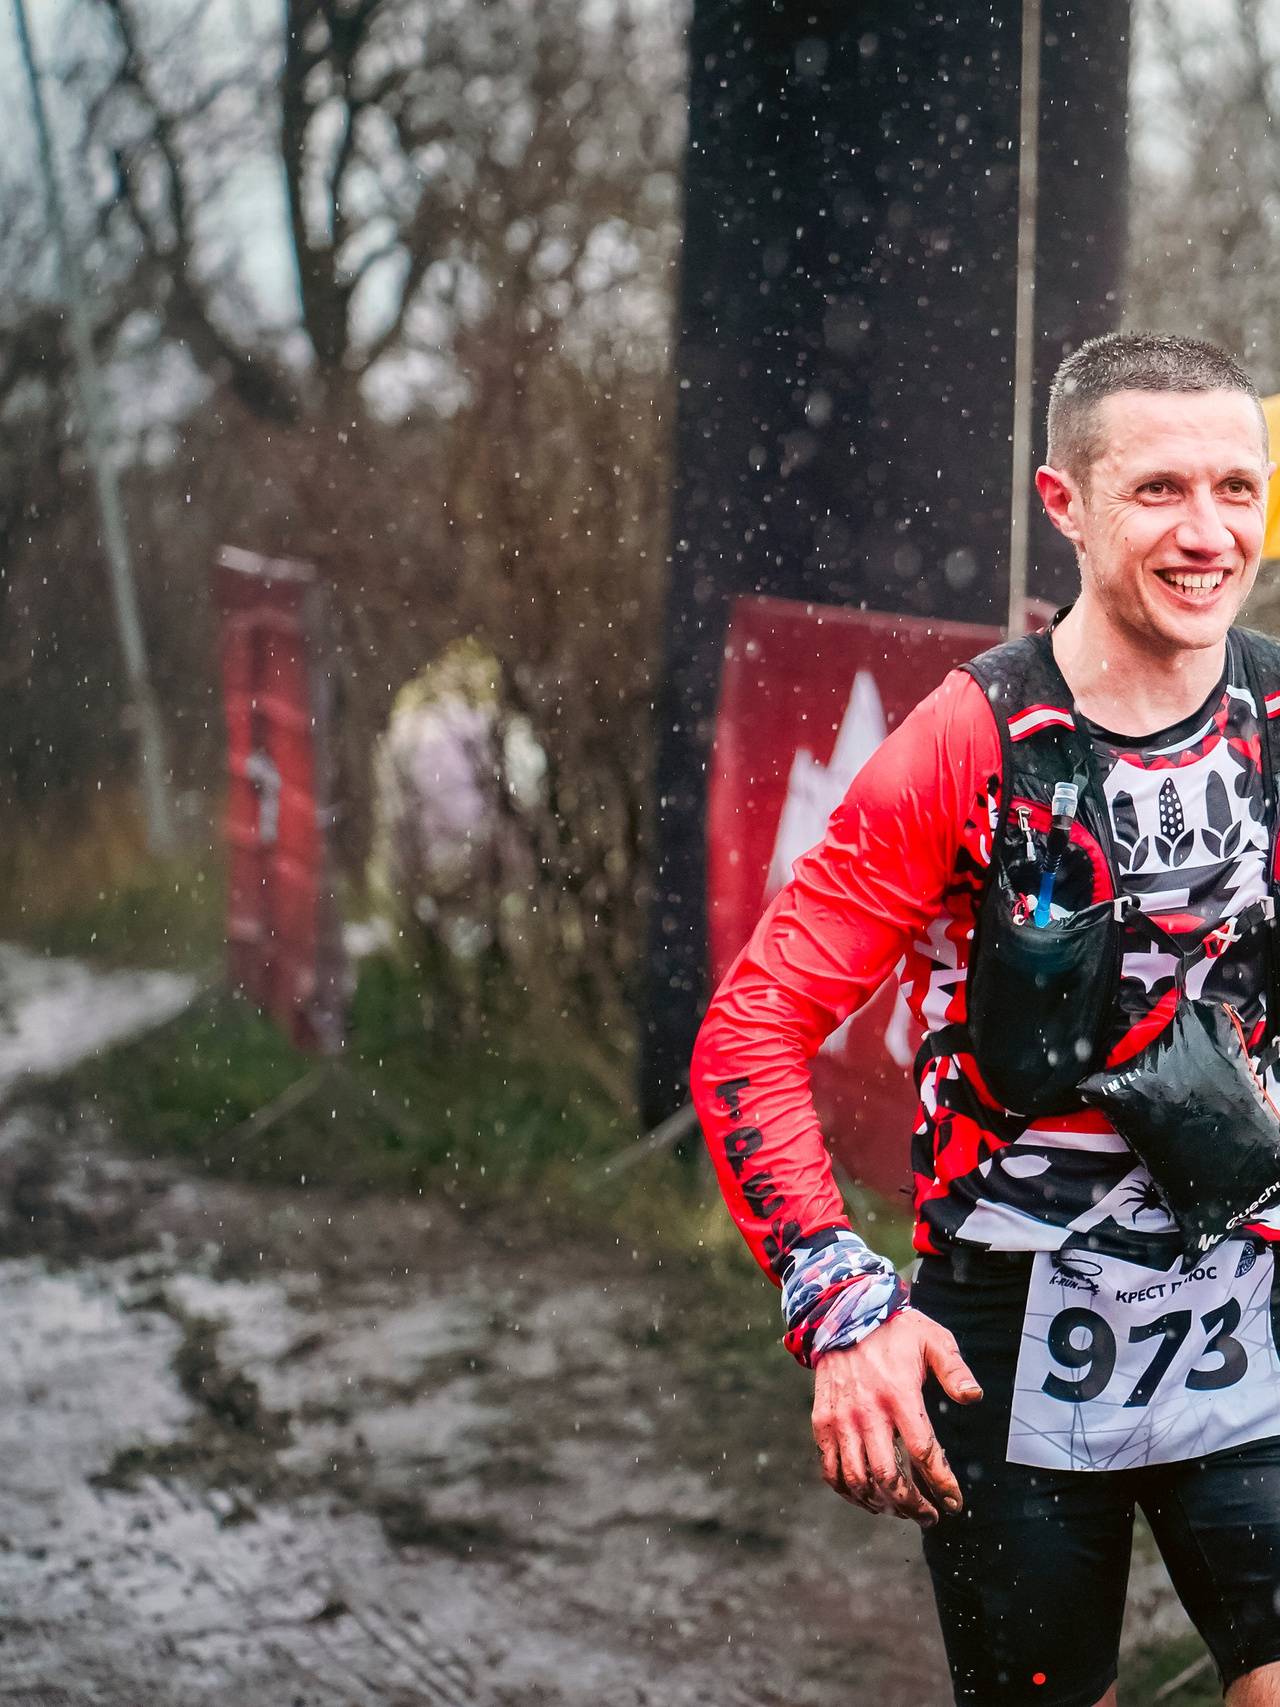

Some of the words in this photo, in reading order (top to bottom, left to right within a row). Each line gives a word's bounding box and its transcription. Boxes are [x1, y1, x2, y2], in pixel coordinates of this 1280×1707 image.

[1049, 1275, 1079, 1289] K-RUN
[1115, 1284, 1166, 1304] КРЕСТ
[1041, 1296, 1249, 1408] 973
